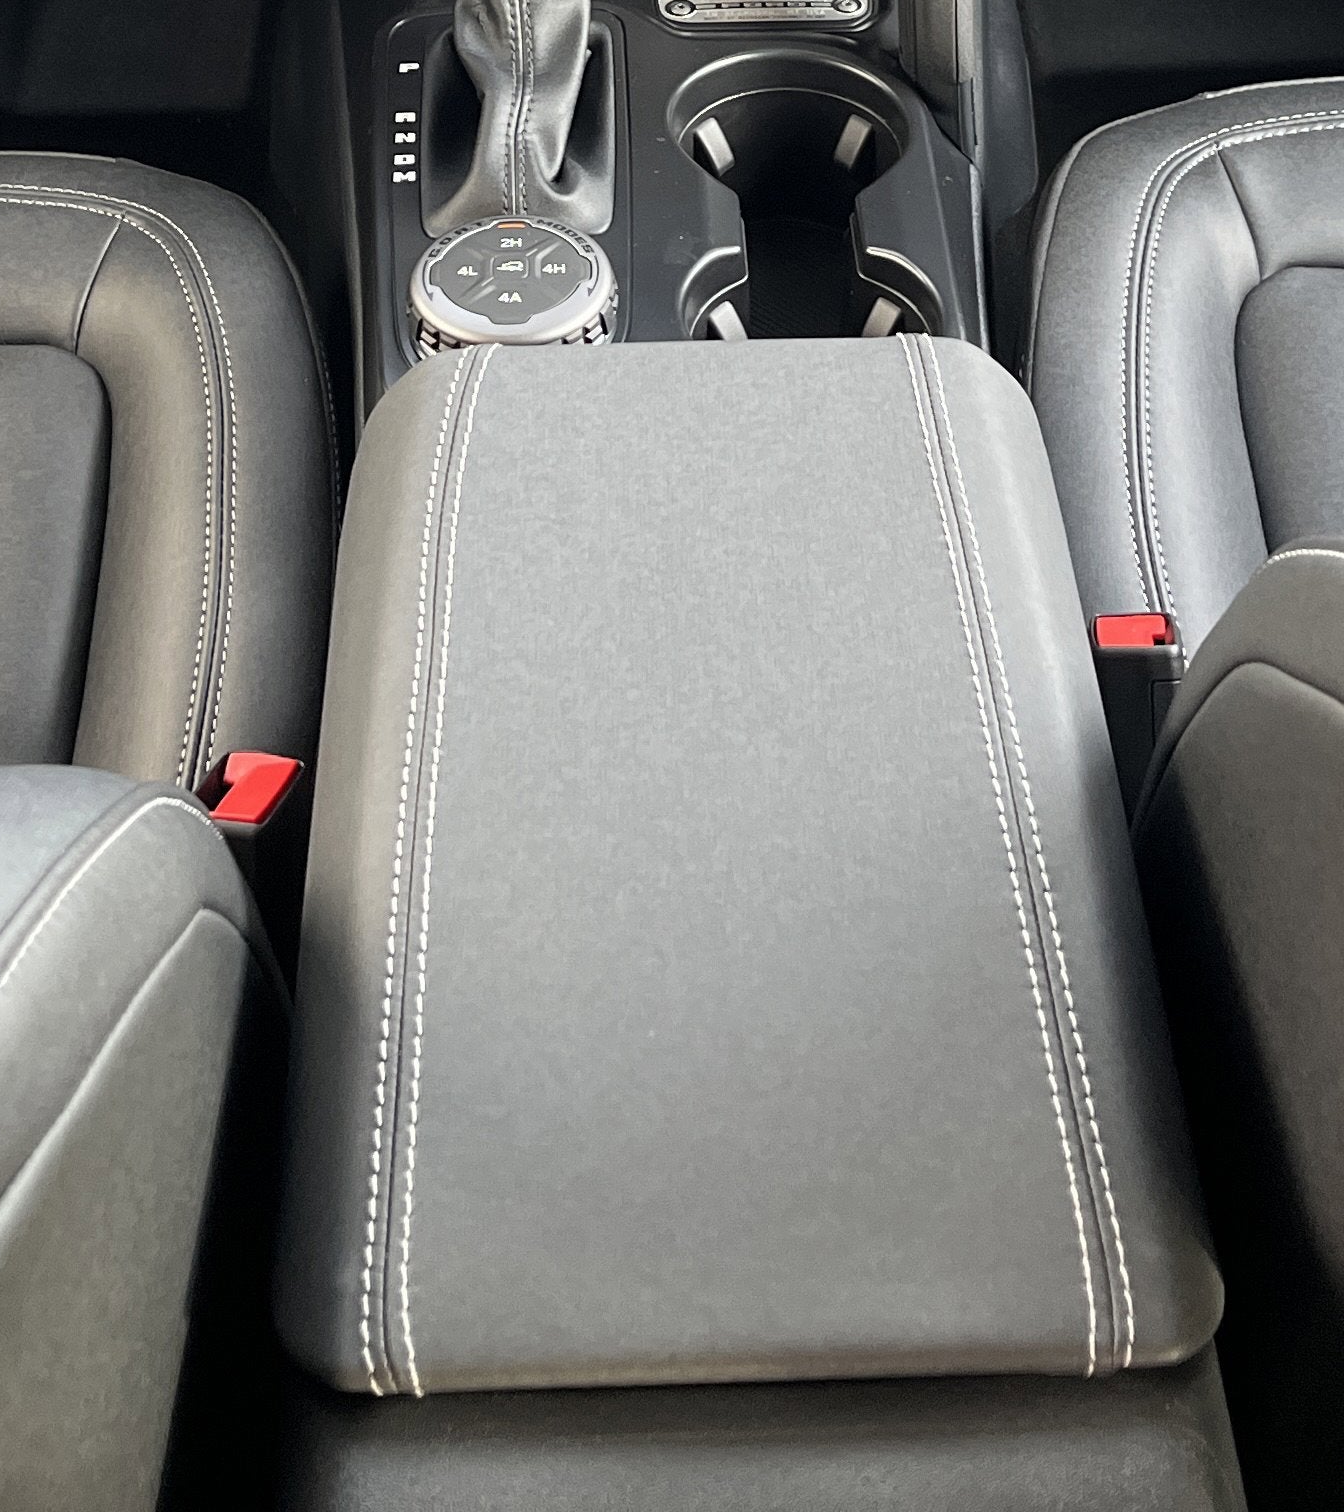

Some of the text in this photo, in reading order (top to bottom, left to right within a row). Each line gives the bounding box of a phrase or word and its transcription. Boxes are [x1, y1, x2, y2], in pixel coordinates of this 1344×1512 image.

[398, 62, 420, 73] P
[394, 132, 416, 143] N
[393, 153, 416, 165] D
[392, 170, 417, 183] M
[500, 237, 523, 248] 2H
[537, 219, 595, 254] MODES
[456, 263, 567, 277] 4L 4H
[497, 291, 523, 304] 4A
